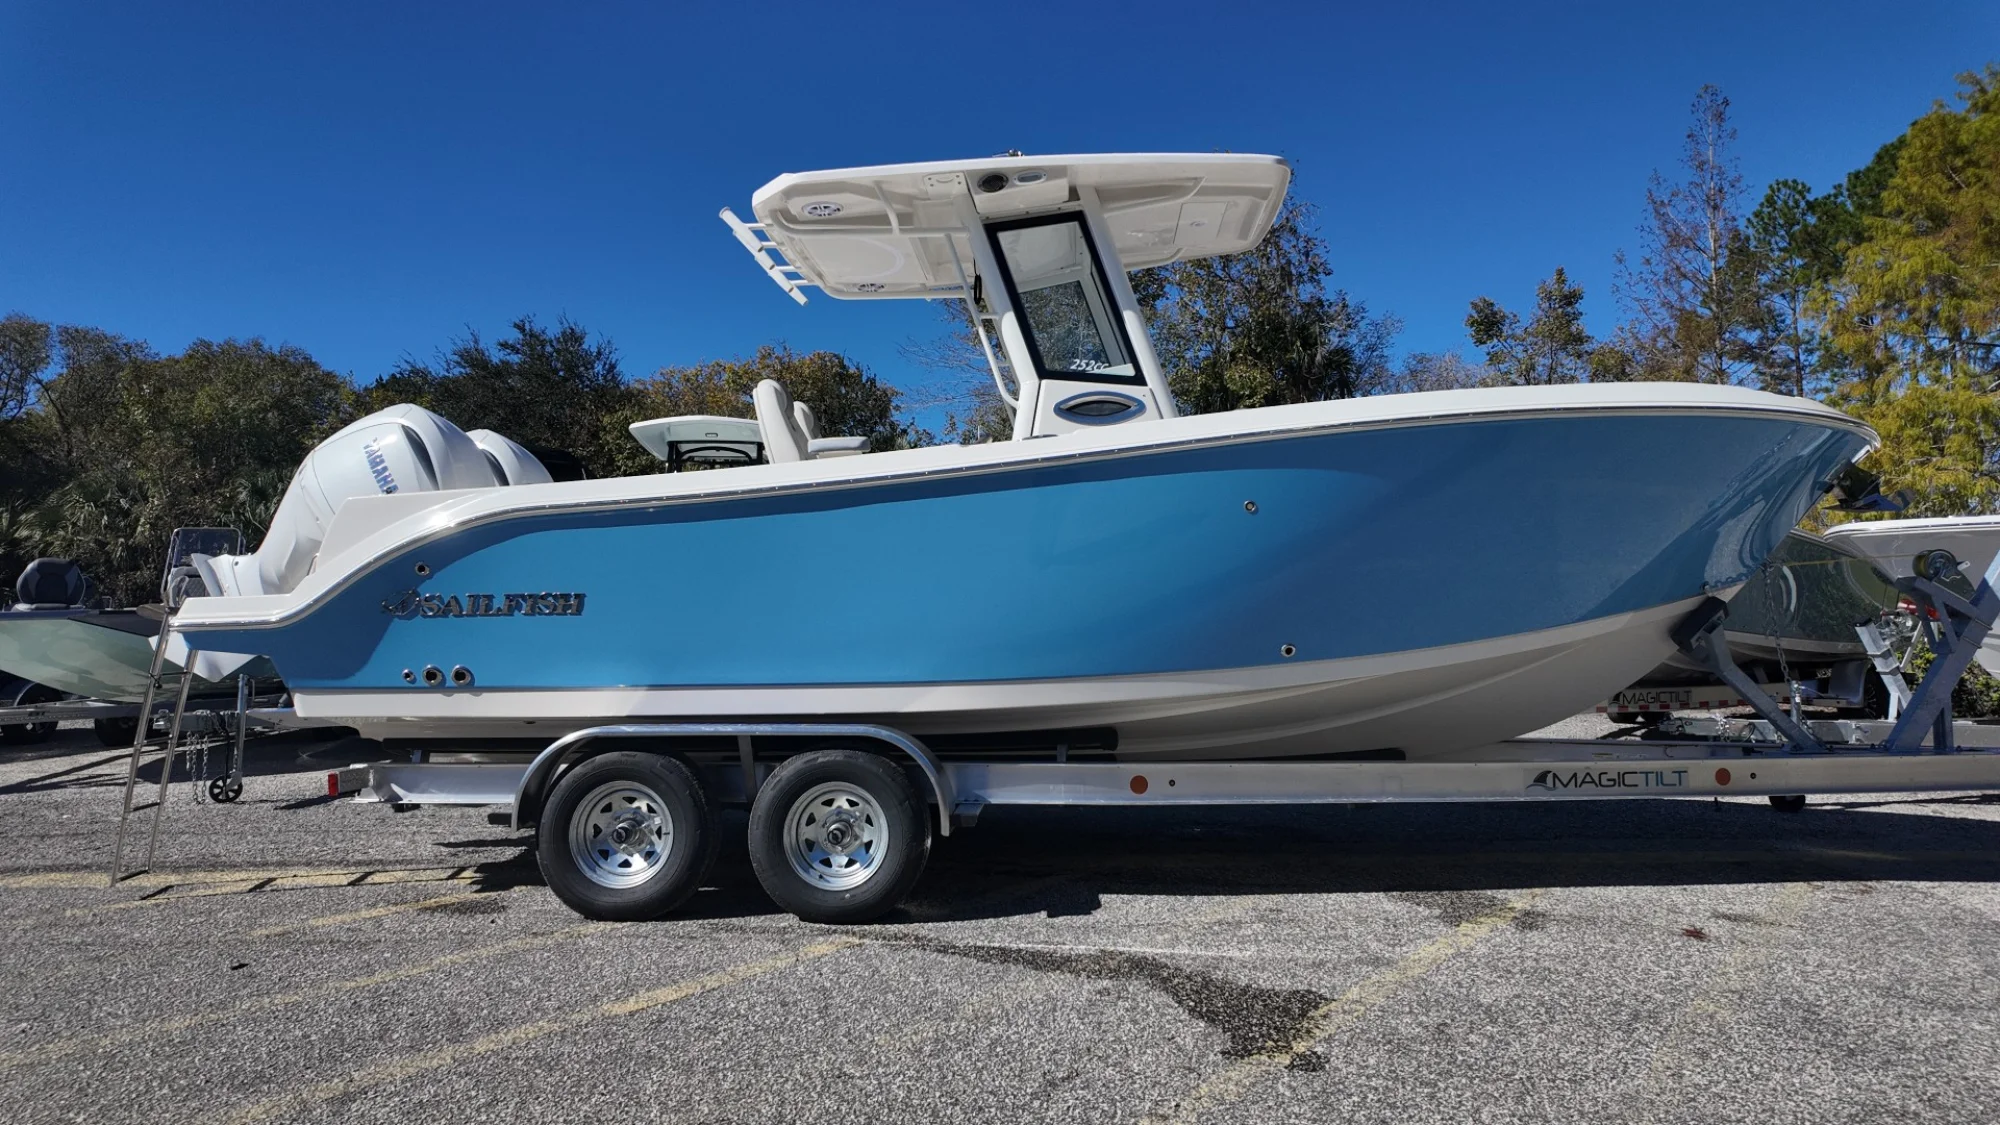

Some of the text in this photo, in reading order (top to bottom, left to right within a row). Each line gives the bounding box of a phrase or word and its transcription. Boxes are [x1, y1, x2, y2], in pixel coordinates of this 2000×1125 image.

[420, 593, 586, 617] SAILFISH
[1622, 690, 1692, 705] MAGICTILT
[1552, 770, 1688, 789] MAGICTILT
